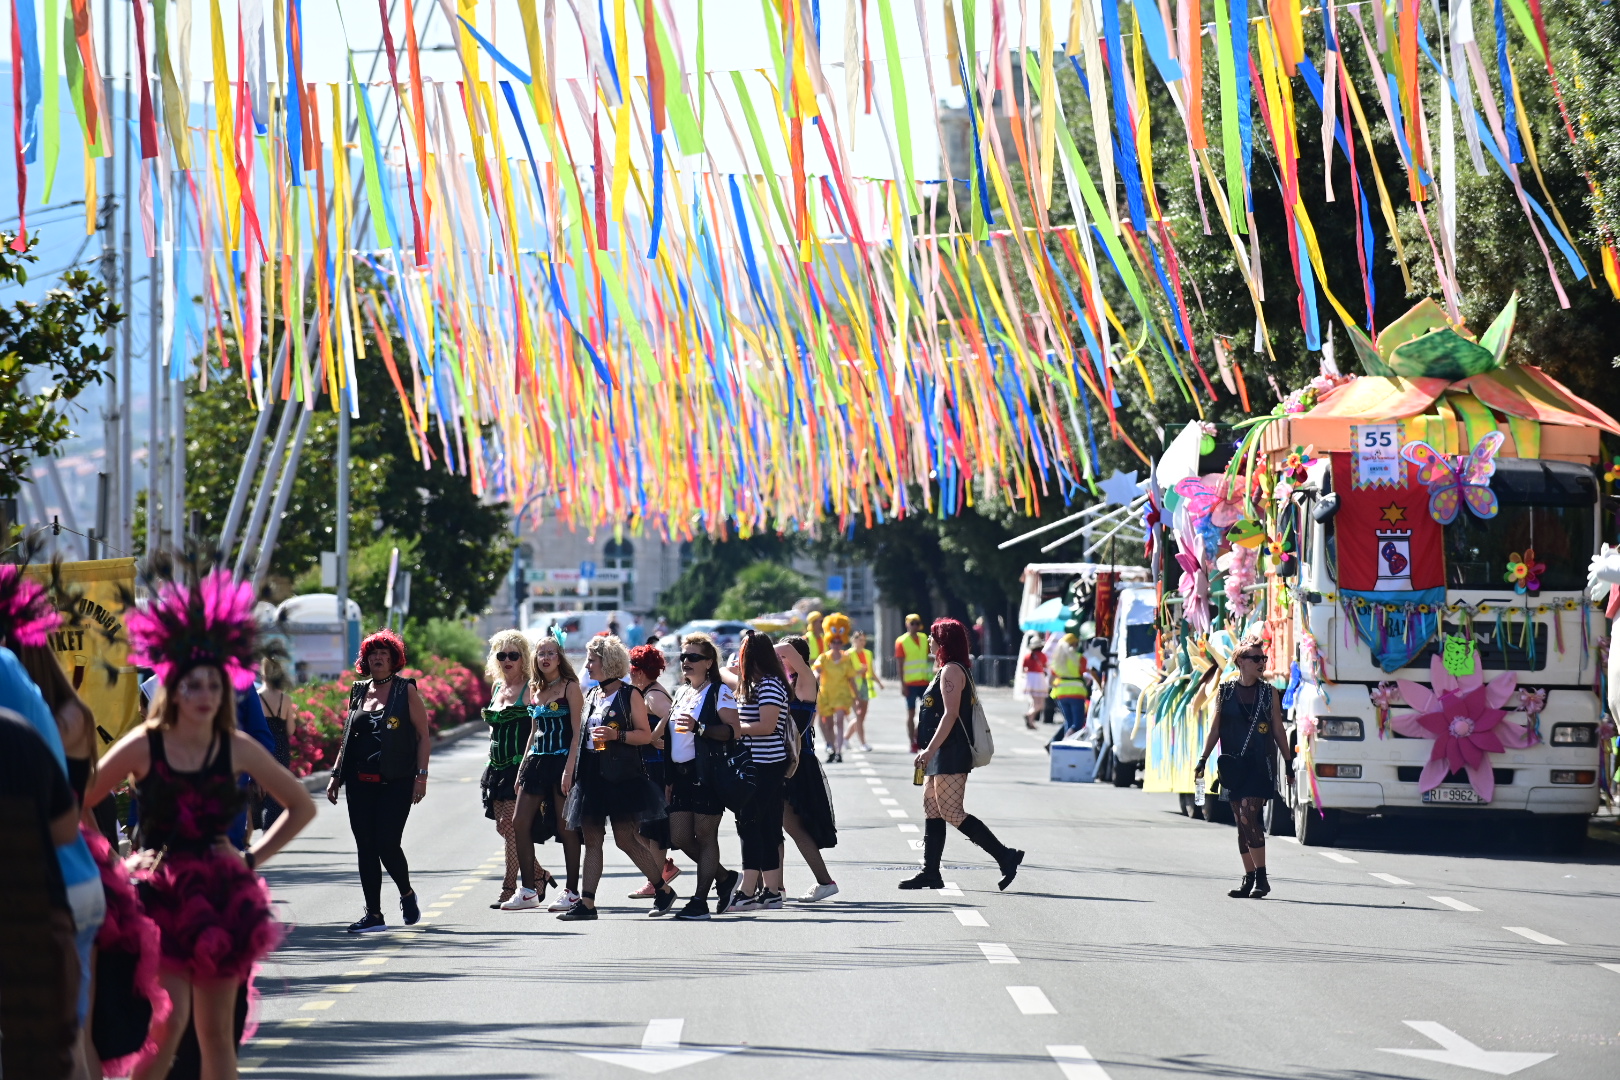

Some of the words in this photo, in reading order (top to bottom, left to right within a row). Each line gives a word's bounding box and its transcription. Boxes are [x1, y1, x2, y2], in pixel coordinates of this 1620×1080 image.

[1364, 431, 1392, 447] 55
[78, 598, 122, 637] UDRUGA
[1430, 789, 1441, 800] RI
